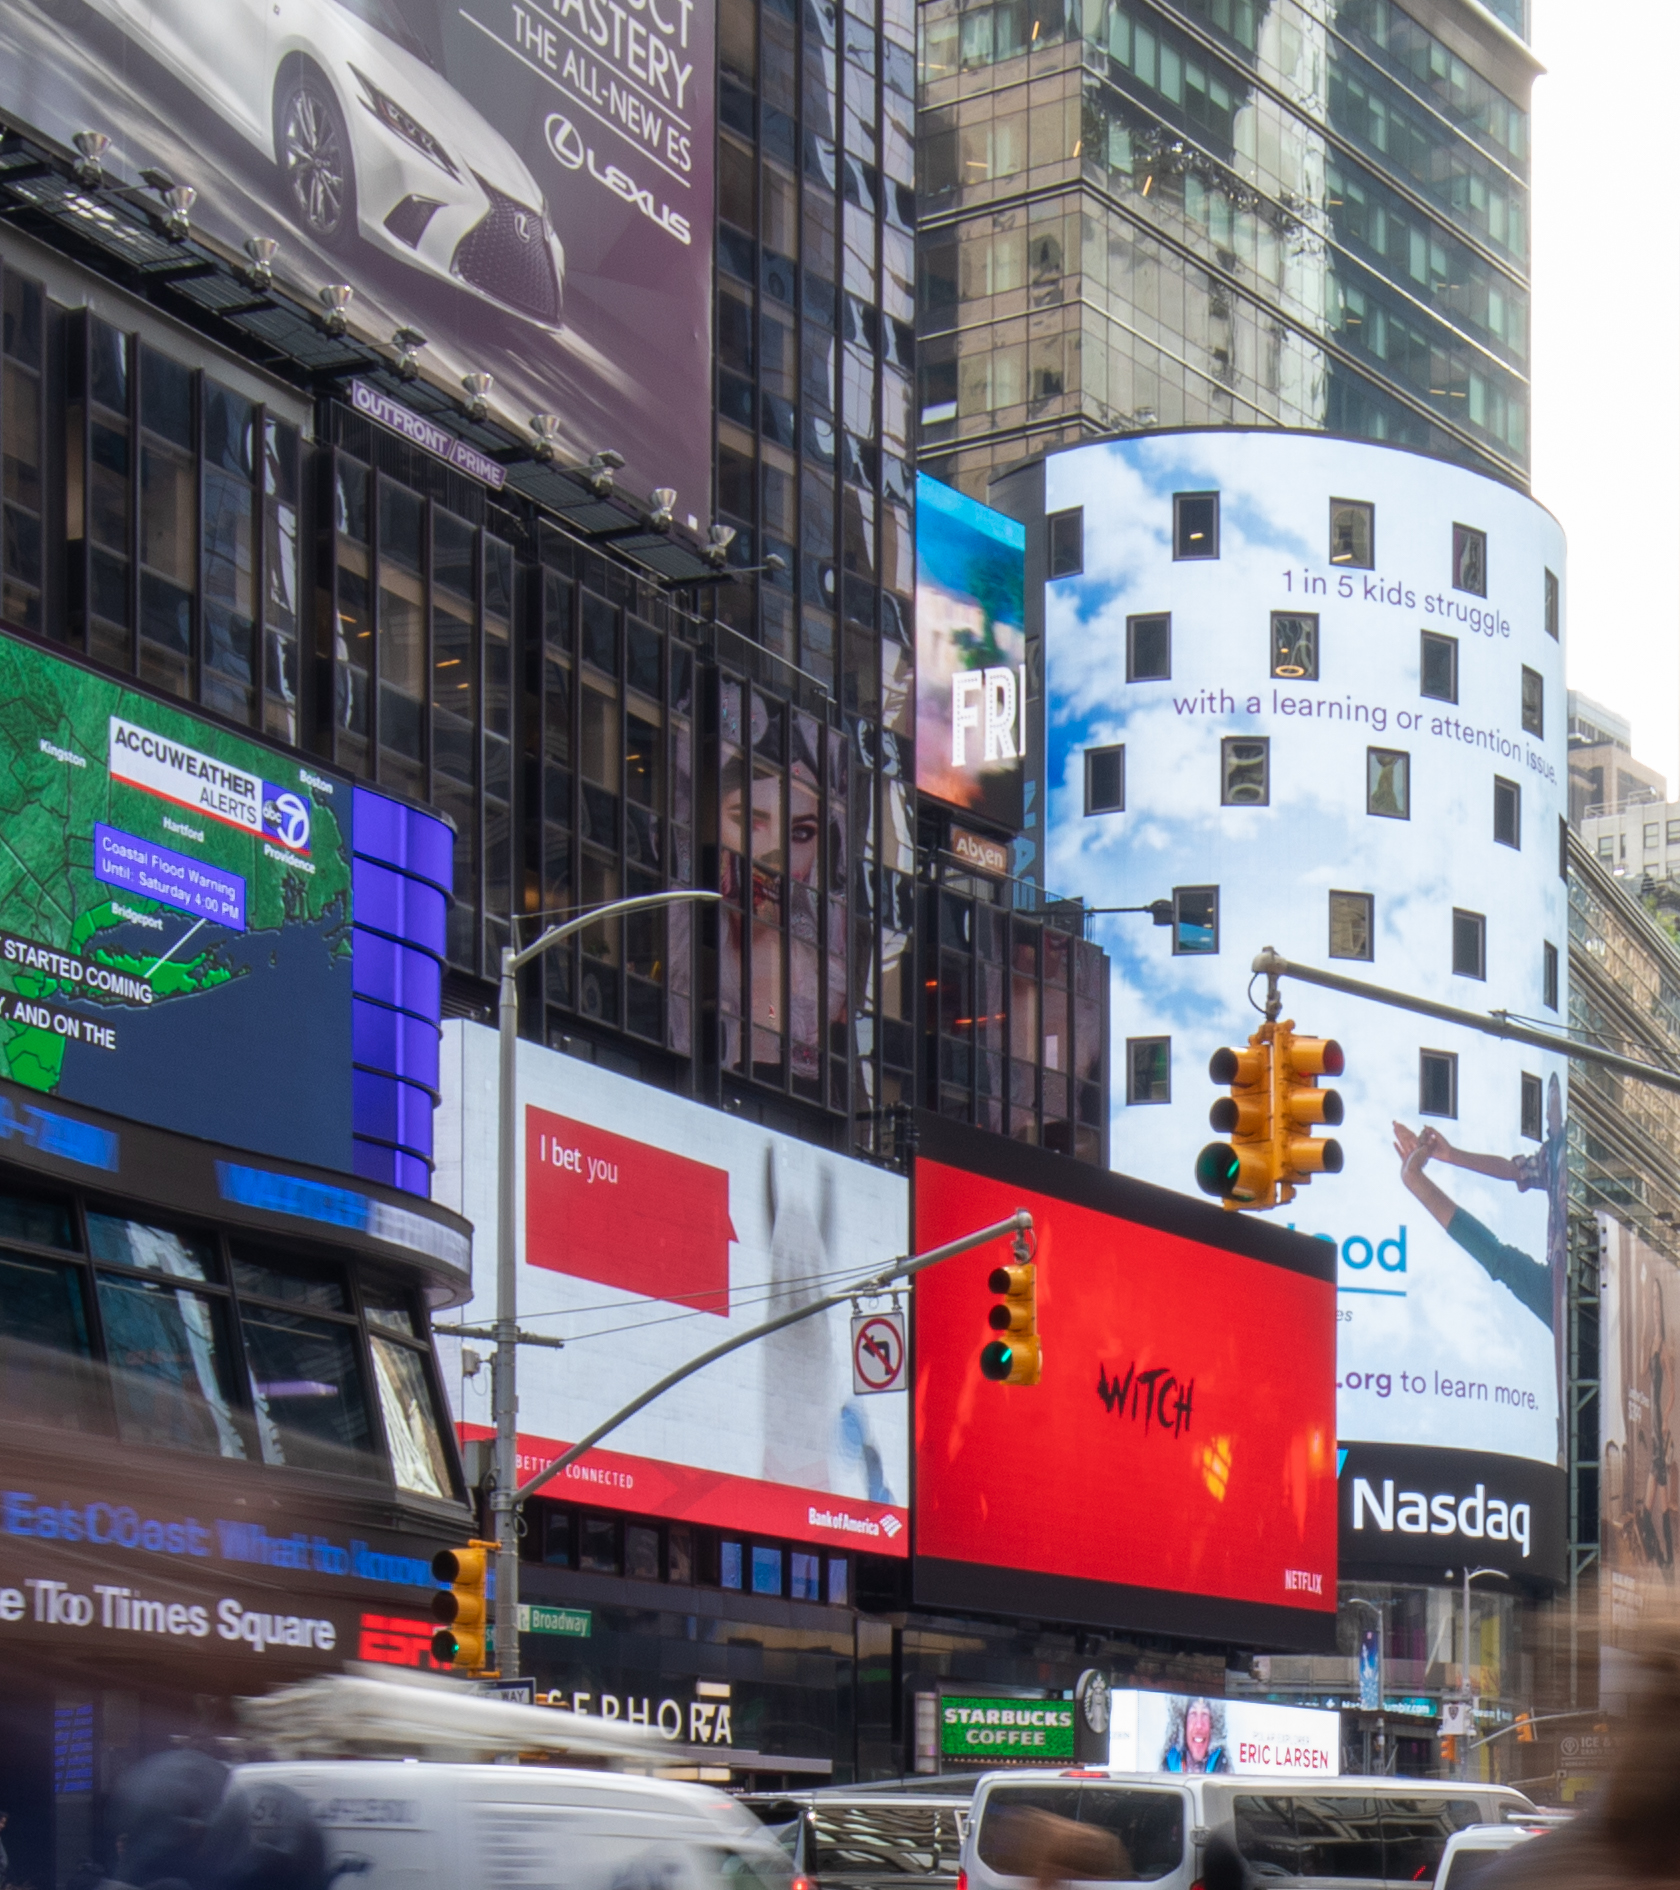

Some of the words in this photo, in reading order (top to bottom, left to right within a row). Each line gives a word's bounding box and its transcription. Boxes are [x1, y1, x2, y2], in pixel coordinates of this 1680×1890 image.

[553, 0, 692, 109] ASTERY
[512, 4, 557, 70] THE
[562, 49, 662, 148] ALL-NEW
[667, 125, 692, 172] ES
[586, 147, 692, 246] LEXUS
[357, 387, 448, 453] OUTFRONT
[457, 445, 504, 486] PRIME
[1282, 569, 1293, 593] 1
[1304, 568, 1327, 595] in
[1337, 575, 1354, 598] 5
[1363, 575, 1416, 608] kids
[1424, 593, 1511, 638] struggle
[39, 738, 87, 768] Kingston
[1172, 686, 1234, 717] with
[1245, 692, 1262, 716] a
[1272, 688, 1387, 732] learning
[1396, 710, 1423, 730] or
[1430, 717, 1521, 763] attention
[1525, 742, 1558, 786] issue.
[115, 725, 256, 801] ACCUWEATHER
[299, 768, 334, 795] Boston
[162, 815, 205, 843] Hartford
[199, 786, 257, 825] ALERTS
[102, 836, 148, 865] Coastal
[151, 854, 185, 880] Flood
[188, 868, 236, 902] Warning
[263, 843, 316, 874] Providence
[111, 902, 164, 931] Bridgeport
[139, 870, 192, 907] Saturday
[194, 892, 219, 915] 4:00
[222, 900, 240, 921] PM
[4, 939, 83, 981] STARTED
[85, 967, 153, 1004] COMING
[13, 1002, 51, 1029] AND
[53, 1014, 80, 1039] ON
[82, 1021, 116, 1050] THE
[551, 1140, 583, 1172] bet
[587, 1153, 619, 1186] you
[1097, 1360, 1195, 1440] WITCH
[1400, 1370, 1427, 1394] to
[1434, 1369, 1488, 1401] learn
[1494, 1385, 1539, 1410] more.
[566, 1463, 634, 1490] CONNECTED
[1352, 1477, 1531, 1557] Nasdaq
[1284, 1568, 1322, 1595] NETFLIX
[92, 1583, 209, 1638] Times
[217, 1598, 336, 1652] Square
[531, 1610, 589, 1633] Broadway
[944, 1707, 1072, 1728] STARBUCKS
[966, 1729, 1046, 1746] COFFEE
[1239, 1742, 1271, 1765] ERIC
[1274, 1746, 1330, 1770] LARSEN
